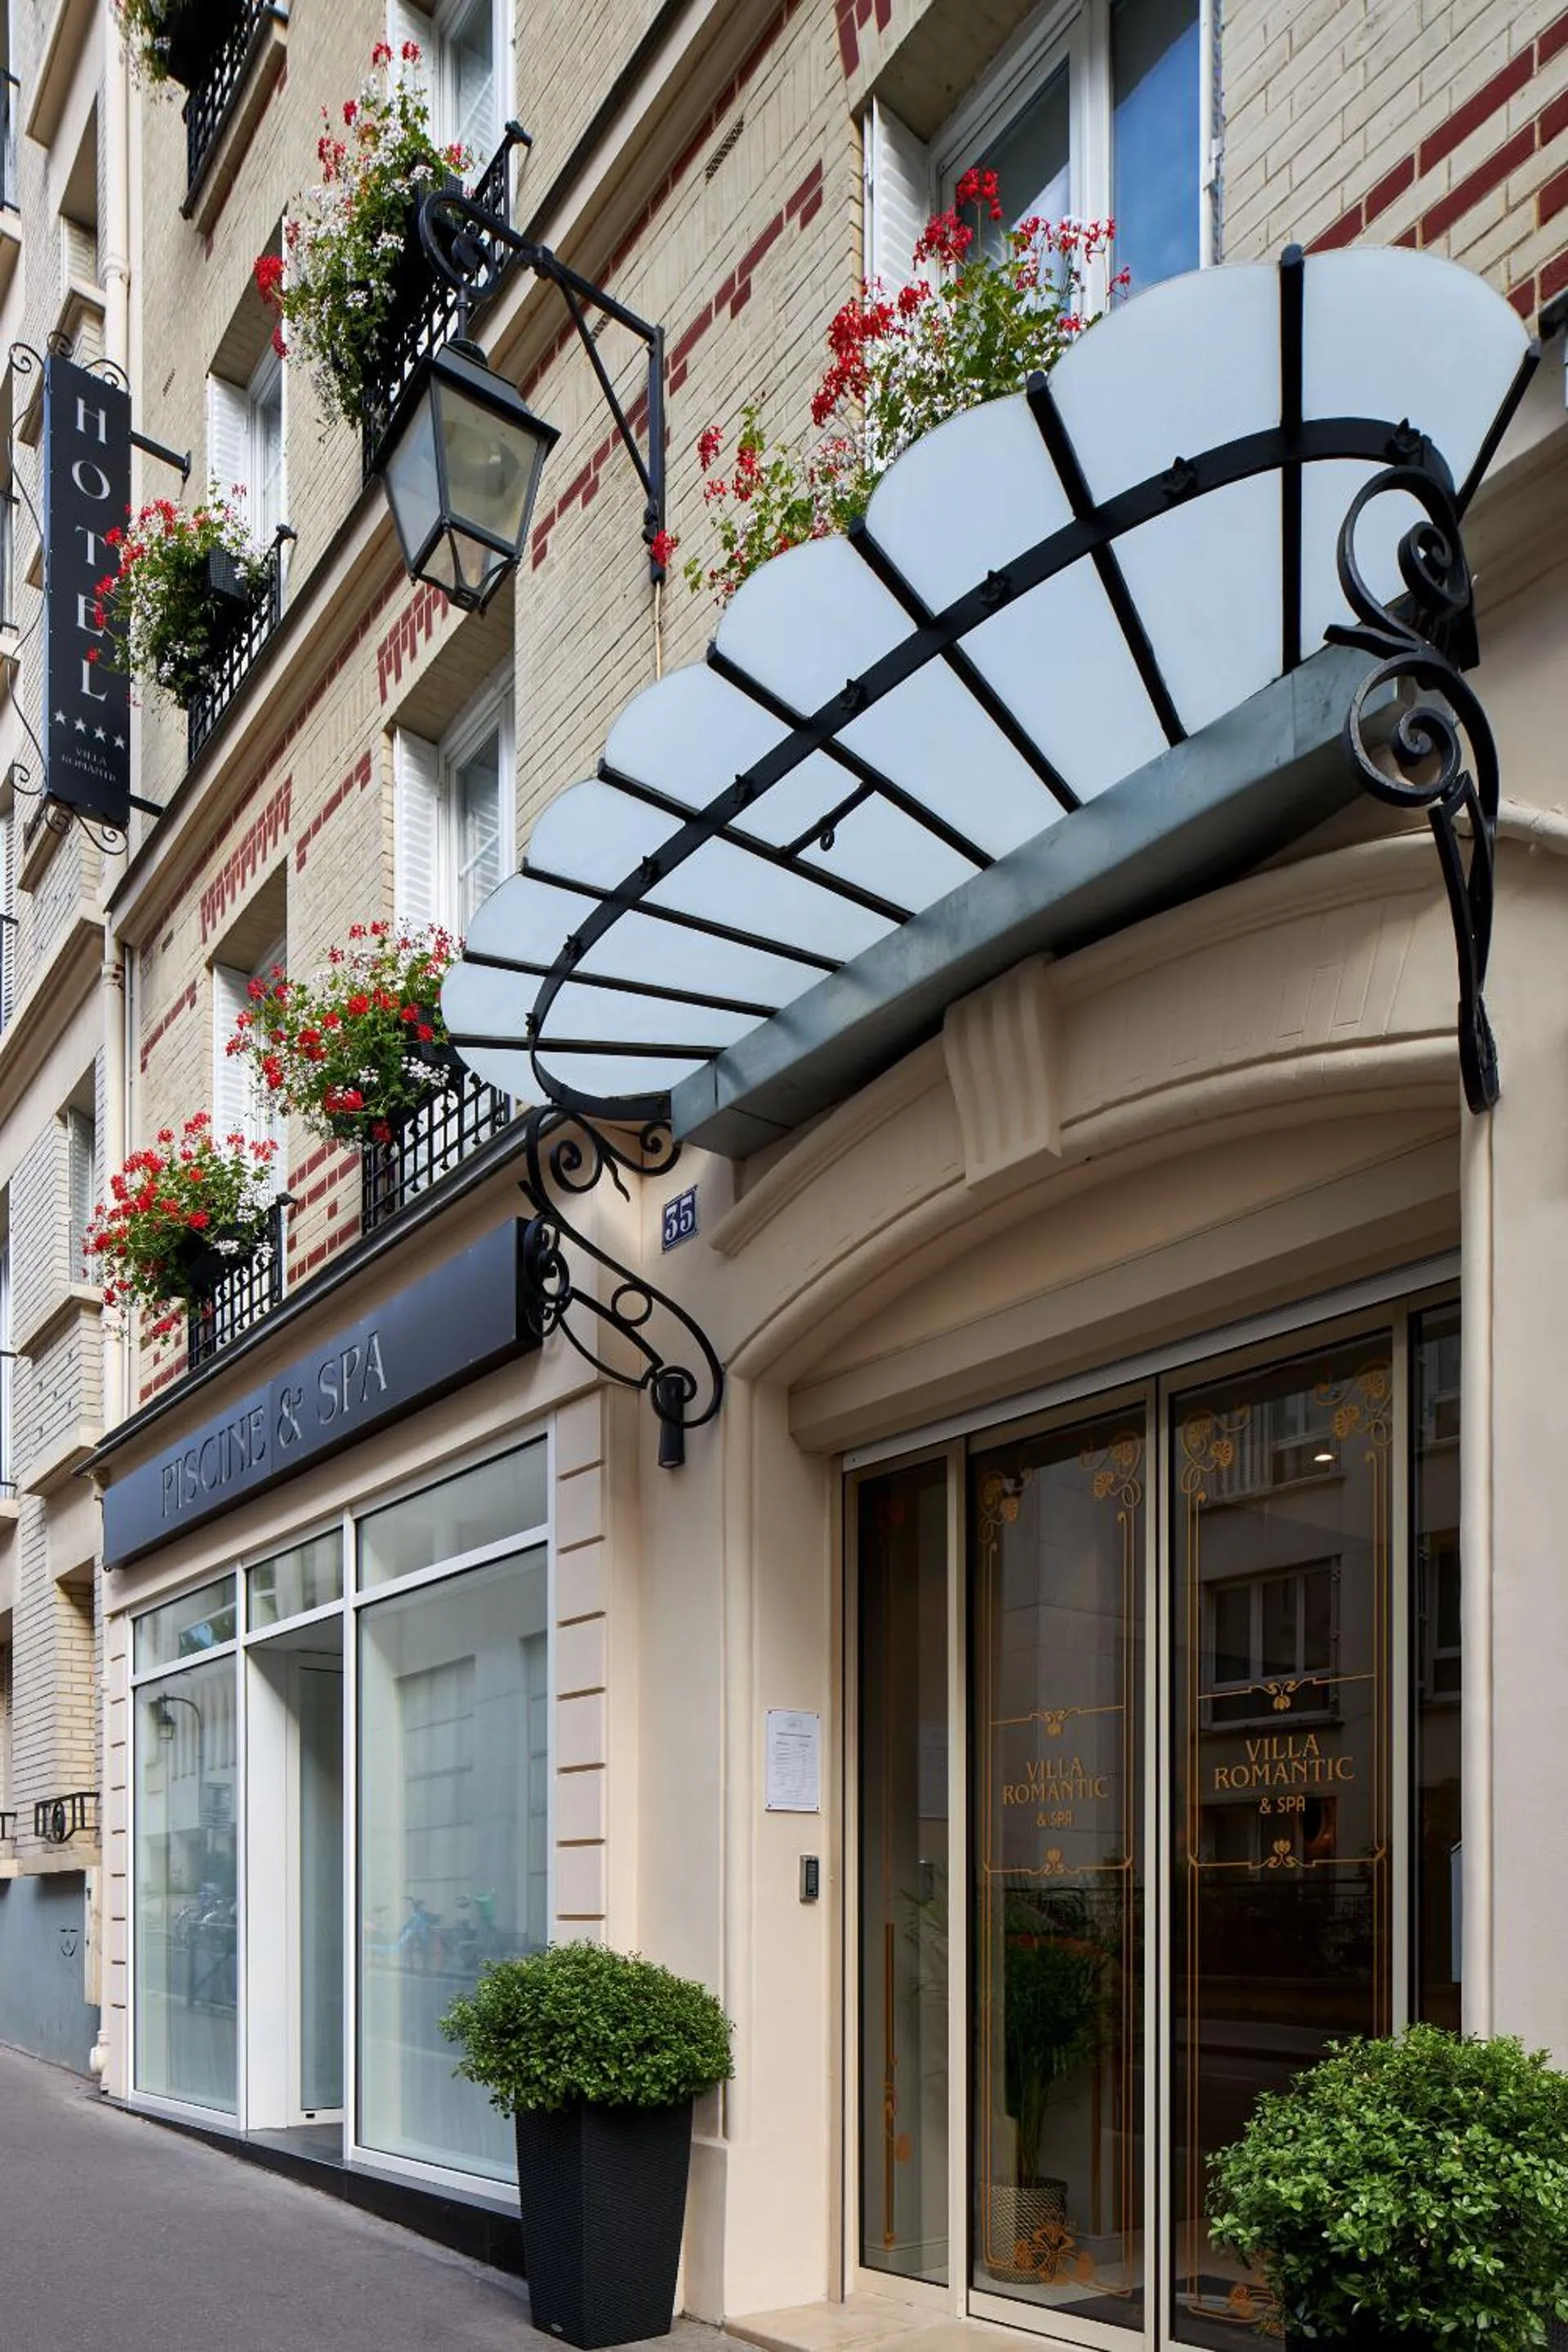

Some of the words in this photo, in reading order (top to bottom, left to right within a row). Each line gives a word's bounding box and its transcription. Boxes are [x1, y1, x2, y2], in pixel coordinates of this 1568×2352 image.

[71, 396, 111, 702] HOTEL
[162, 1404, 265, 1519] PISCINE
[277, 1386, 303, 1449] &
[316, 1330, 387, 1424] SPA
[1245, 1733, 1321, 1762] VILLA
[1026, 1757, 1085, 1781] VILLA
[1214, 1756, 1356, 1791] ROMANTIC
[1002, 1775, 1110, 1806] ROMANTIC
[1258, 1797, 1272, 1815] &
[1276, 1795, 1306, 1814] SPA
[1036, 1811, 1047, 1829] &
